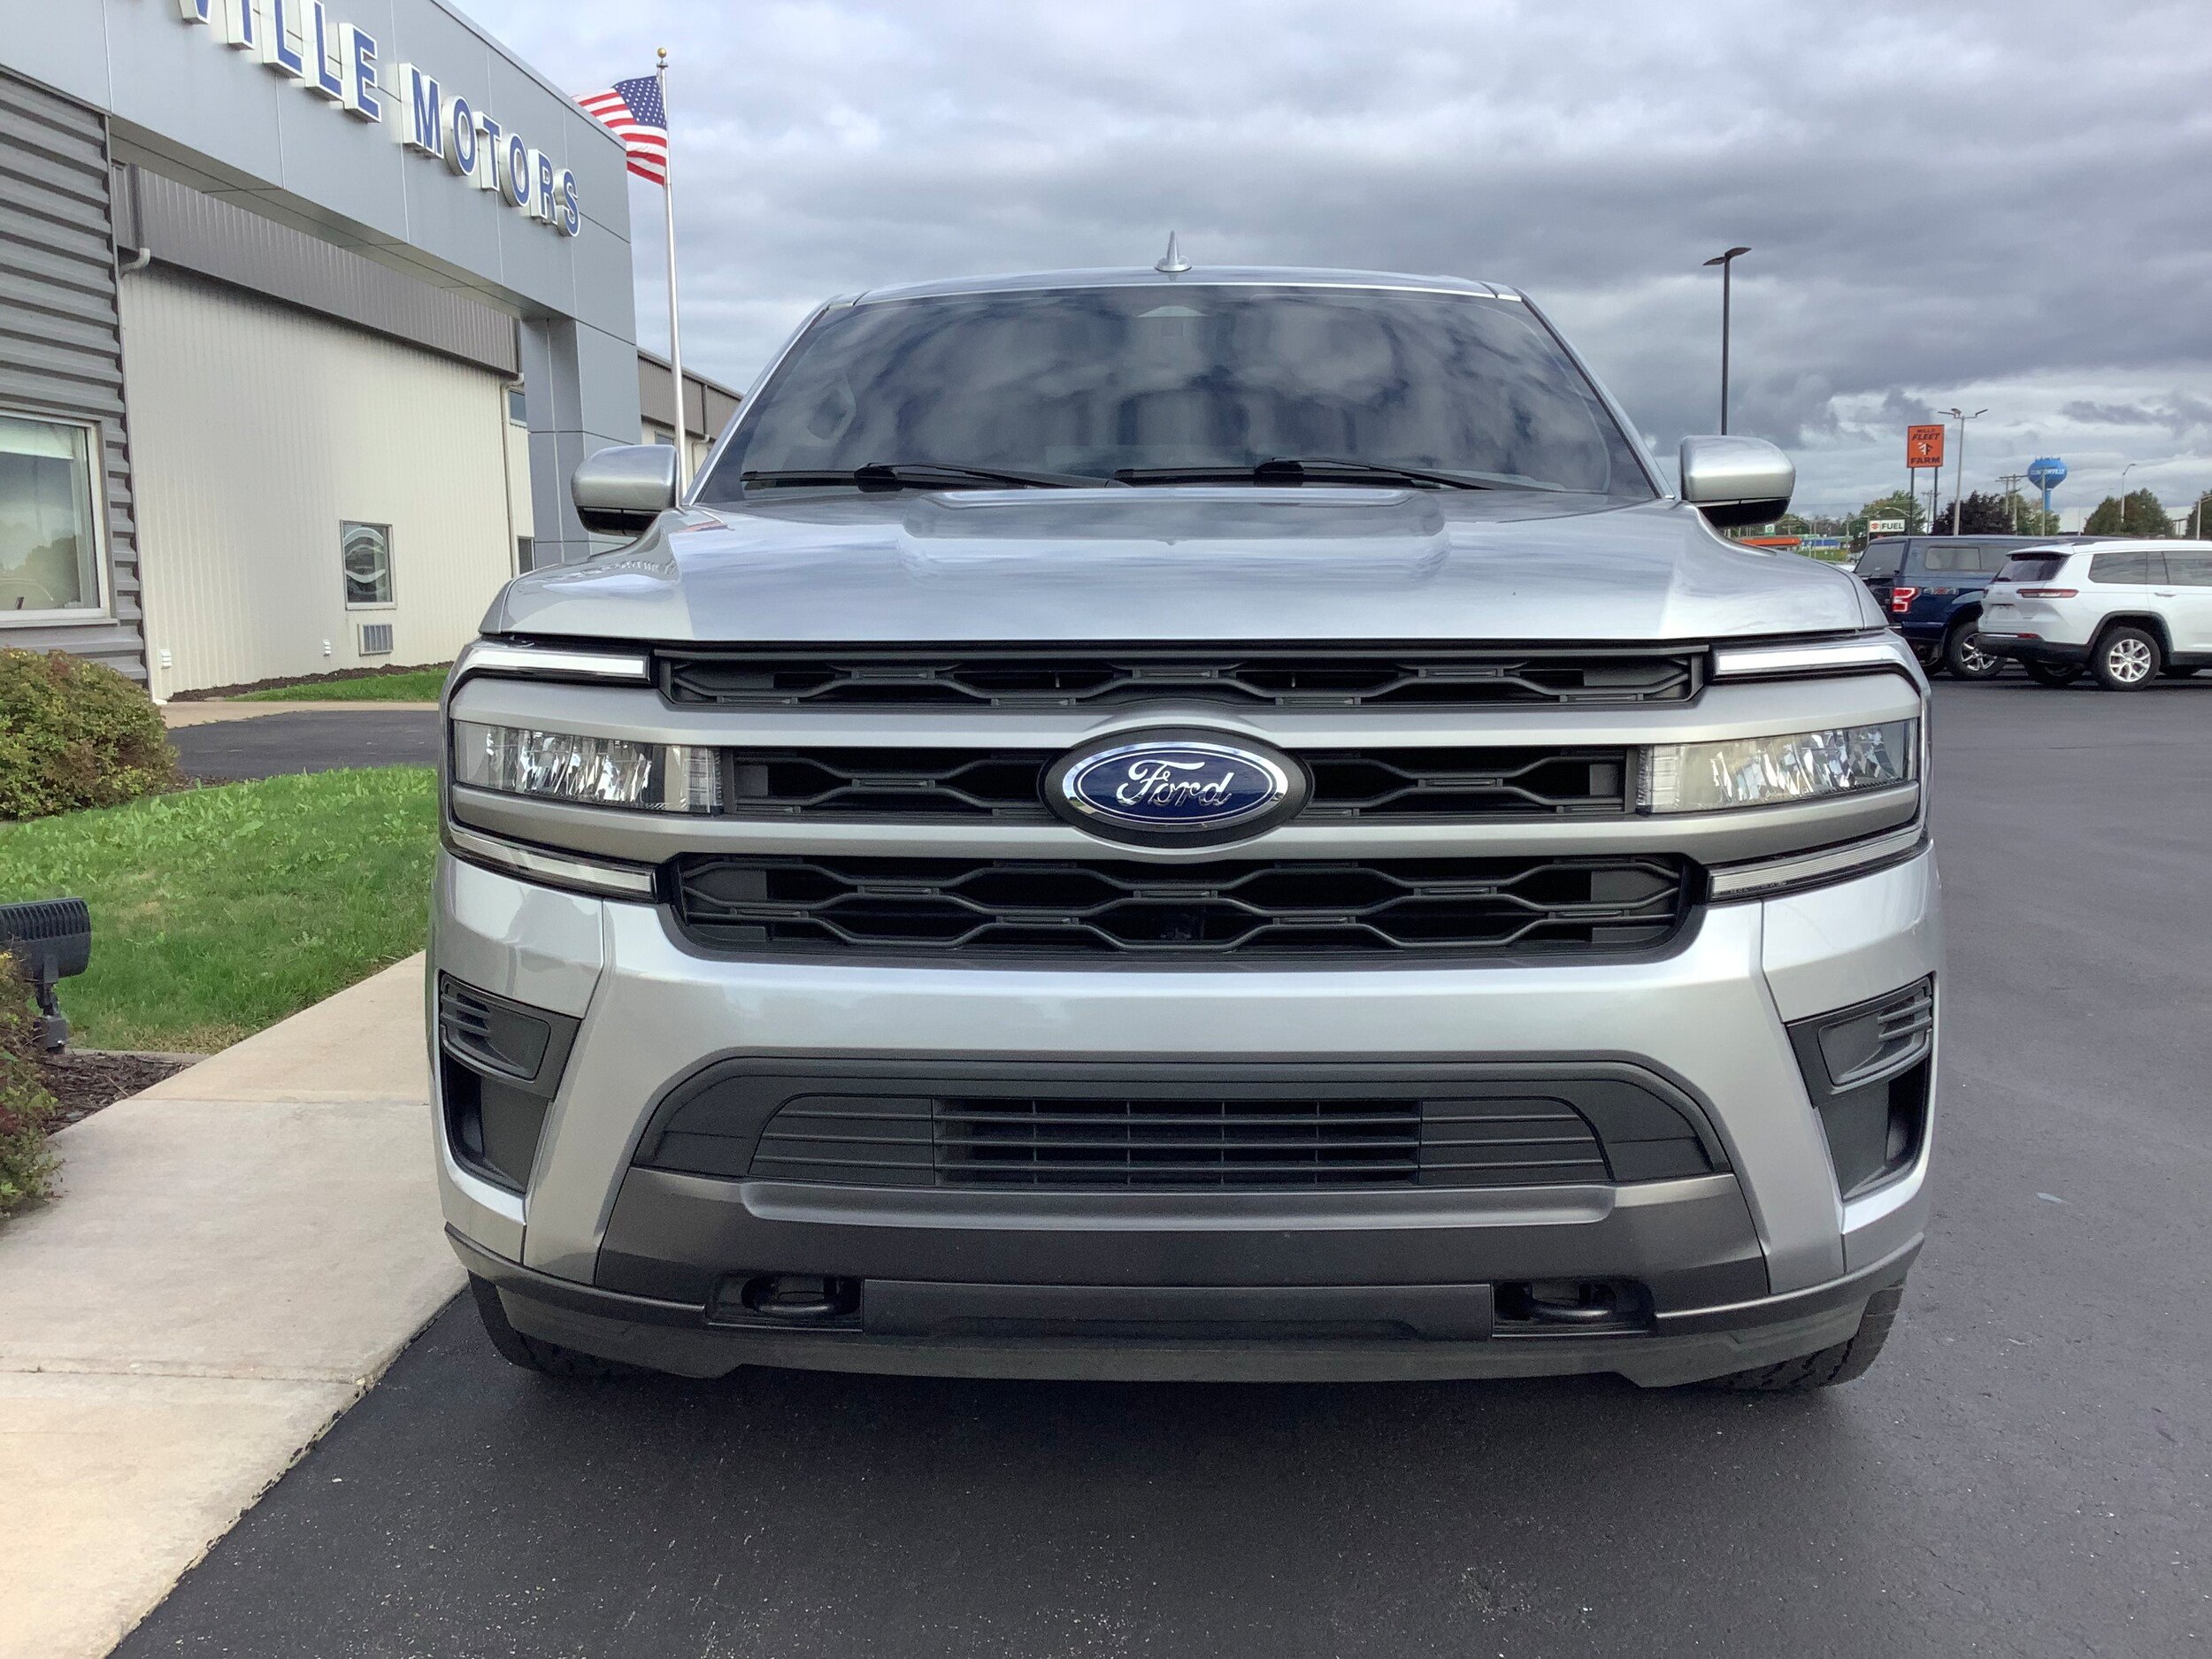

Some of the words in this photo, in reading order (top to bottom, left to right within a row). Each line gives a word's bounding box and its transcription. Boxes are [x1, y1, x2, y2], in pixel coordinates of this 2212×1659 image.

[180, 0, 381, 123] ILLE
[401, 63, 581, 237] MOTORS
[1116, 759, 1235, 807] Ford
